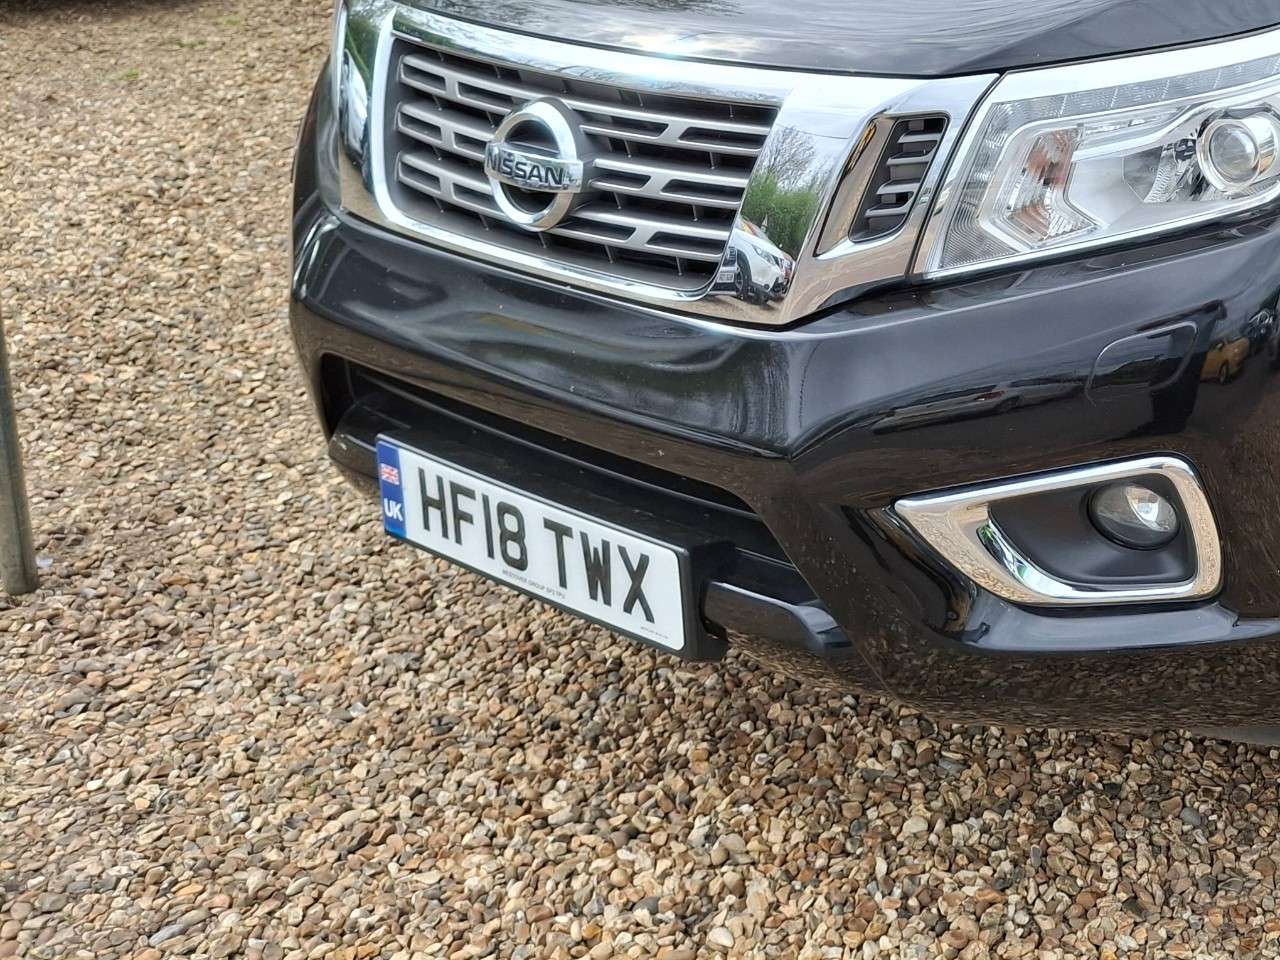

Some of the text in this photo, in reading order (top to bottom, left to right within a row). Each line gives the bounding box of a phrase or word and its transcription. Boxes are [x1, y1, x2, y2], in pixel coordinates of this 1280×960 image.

[486, 149, 564, 186] NISSAN
[383, 497, 404, 522] UK
[417, 467, 655, 624] HF18 TWX
